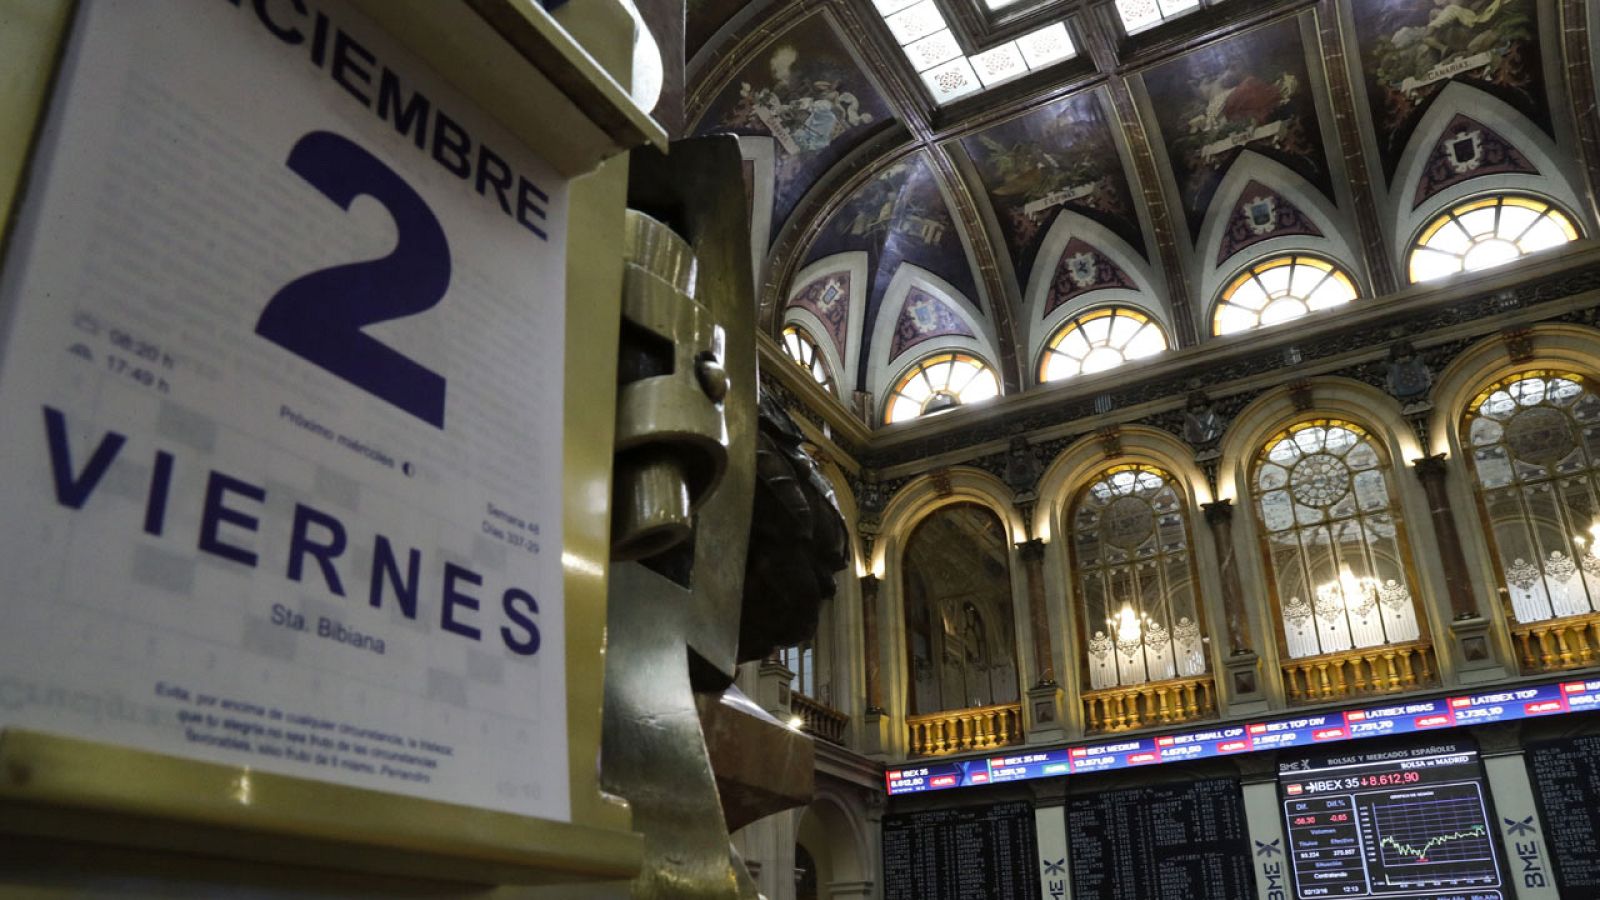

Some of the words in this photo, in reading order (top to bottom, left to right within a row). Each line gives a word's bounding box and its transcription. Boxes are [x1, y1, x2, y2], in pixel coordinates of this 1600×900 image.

[228, 0, 548, 242] CIEMBRE
[255, 130, 451, 430] 2
[487, 502, 525, 530] Semana
[42, 404, 542, 656] VIERNES
[271, 603, 310, 632] Sta.
[318, 616, 386, 655] Bibiana
[1471, 692, 1515, 706] LATIBEX
[1515, 689, 1539, 700] TOP
[269, 707, 283, 720] de
[1365, 706, 1405, 719] LATIBEX
[1267, 722, 1289, 732] IBEX
[1289, 719, 1308, 729] TOP
[1309, 717, 1326, 726] DIV
[1174, 734, 1195, 745] IBEX
[1195, 731, 1224, 741] SMALL
[1224, 728, 1244, 737] CAP
[338, 740, 350, 752] de
[1087, 746, 1106, 756] IBEX
[1107, 742, 1140, 753] MEDIUM
[315, 752, 328, 766] de
[1005, 756, 1023, 766] IBEX
[1327, 756, 1356, 766] BOLSAS
[1366, 750, 1409, 761] MERCADOS
[1411, 745, 1456, 757] ESPAÑOLES
[1401, 760, 1426, 769] BOLSA
[1435, 756, 1470, 765] MADRID
[902, 769, 919, 778] IBEX
[920, 768, 928, 776] 35
[1314, 779, 1343, 792] IBEX
[1345, 777, 1360, 789] 35
[1515, 841, 1546, 888] BME
[1263, 862, 1285, 900] BME
